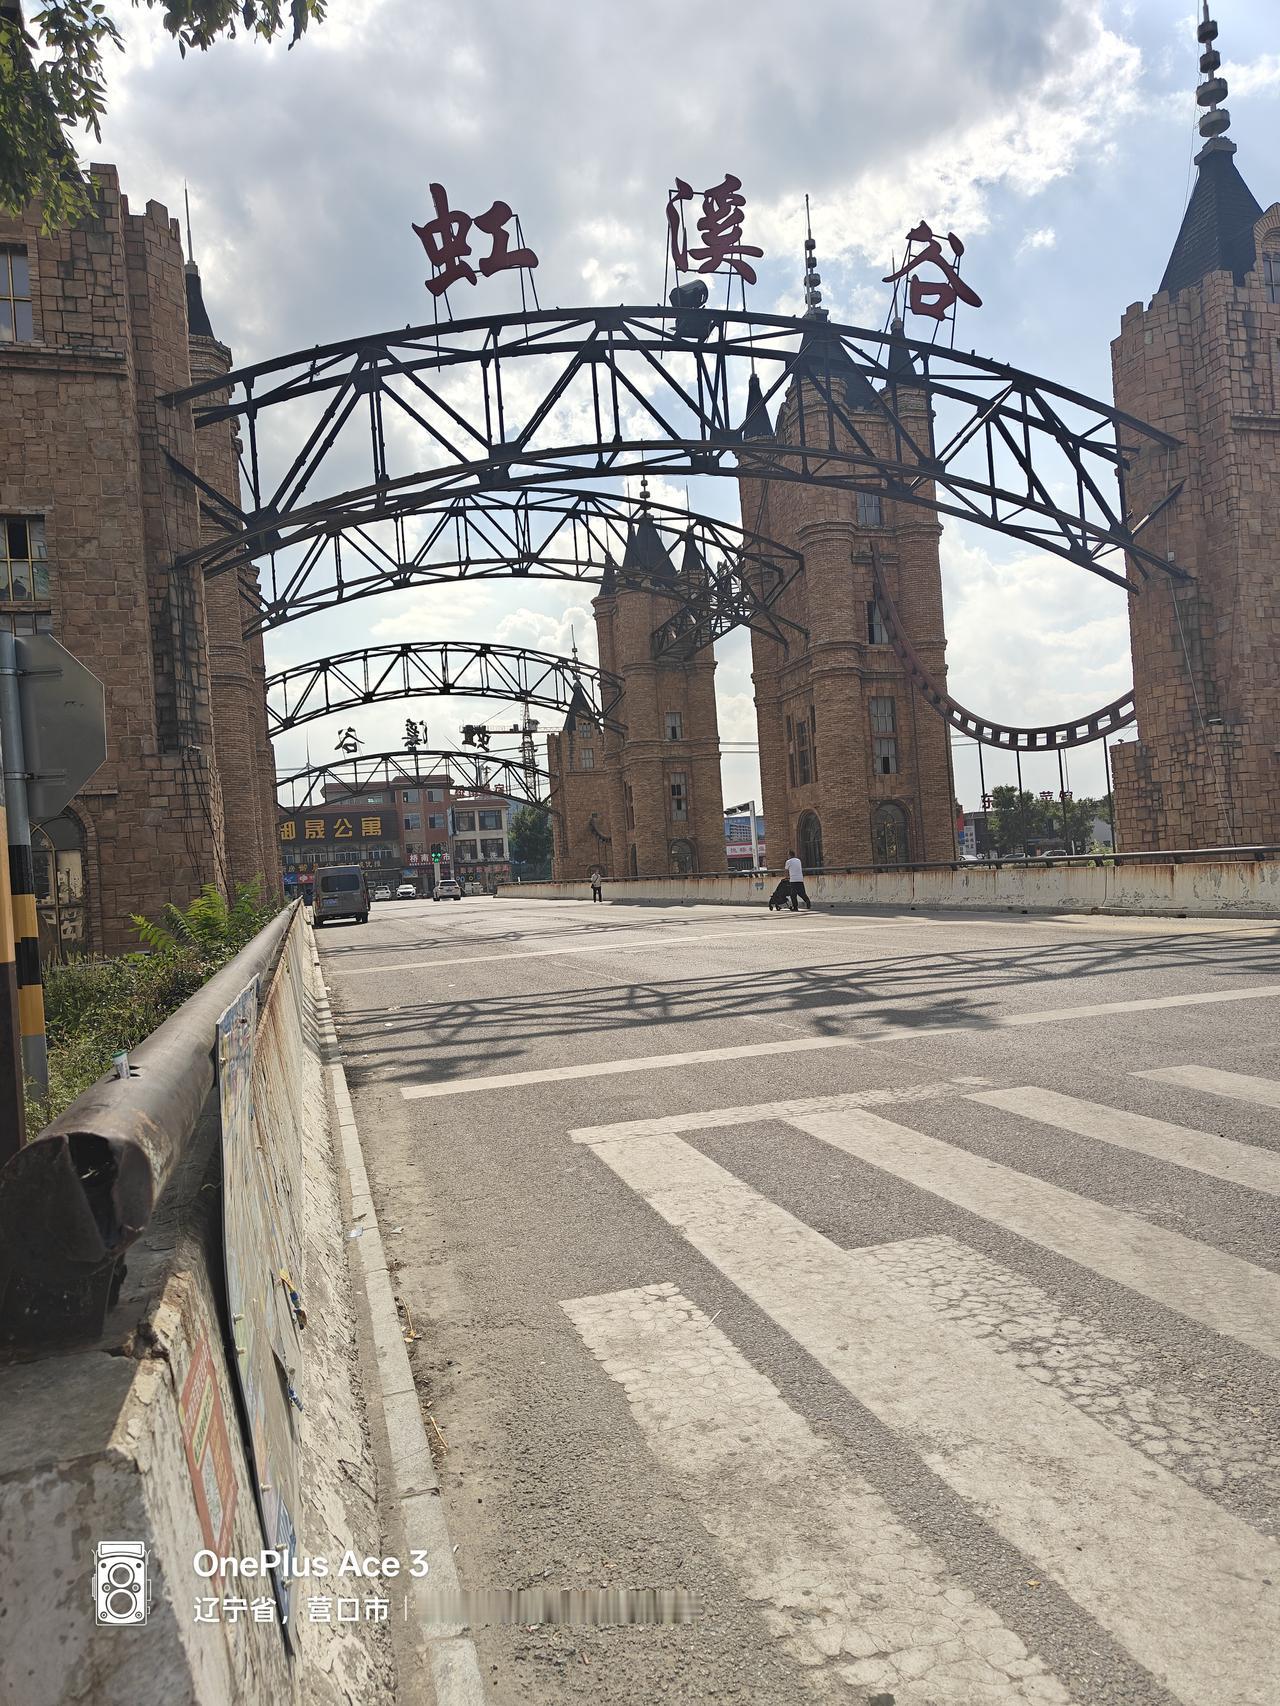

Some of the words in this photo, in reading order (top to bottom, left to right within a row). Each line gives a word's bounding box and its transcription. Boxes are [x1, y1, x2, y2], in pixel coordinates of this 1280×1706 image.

[411, 173, 984, 322] 虹溪谷
[410, 852, 451, 862] 桥南市
